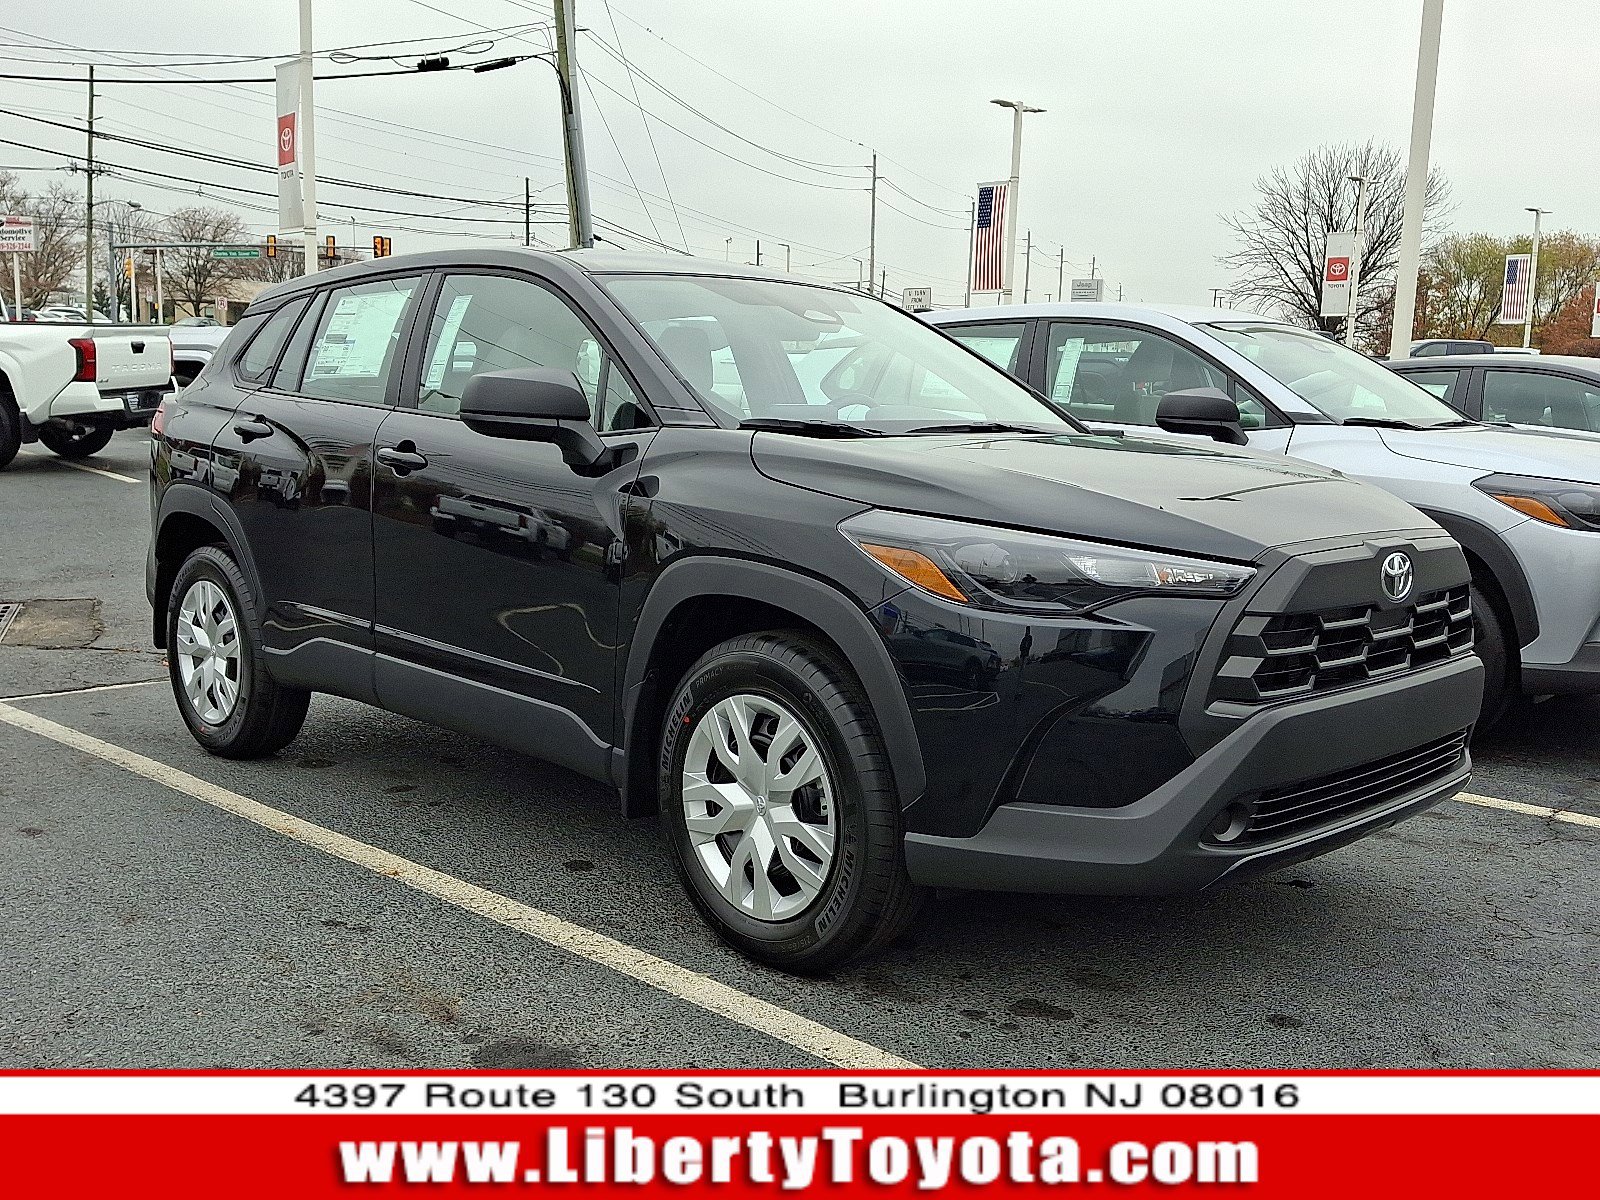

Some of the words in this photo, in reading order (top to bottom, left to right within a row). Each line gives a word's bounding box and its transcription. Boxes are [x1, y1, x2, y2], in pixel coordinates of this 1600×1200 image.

[112, 362, 162, 372] TACOMA
[696, 667, 723, 688] PRIMACY
[660, 692, 692, 772] MICHELIN
[817, 850, 856, 933] MICHELIN
